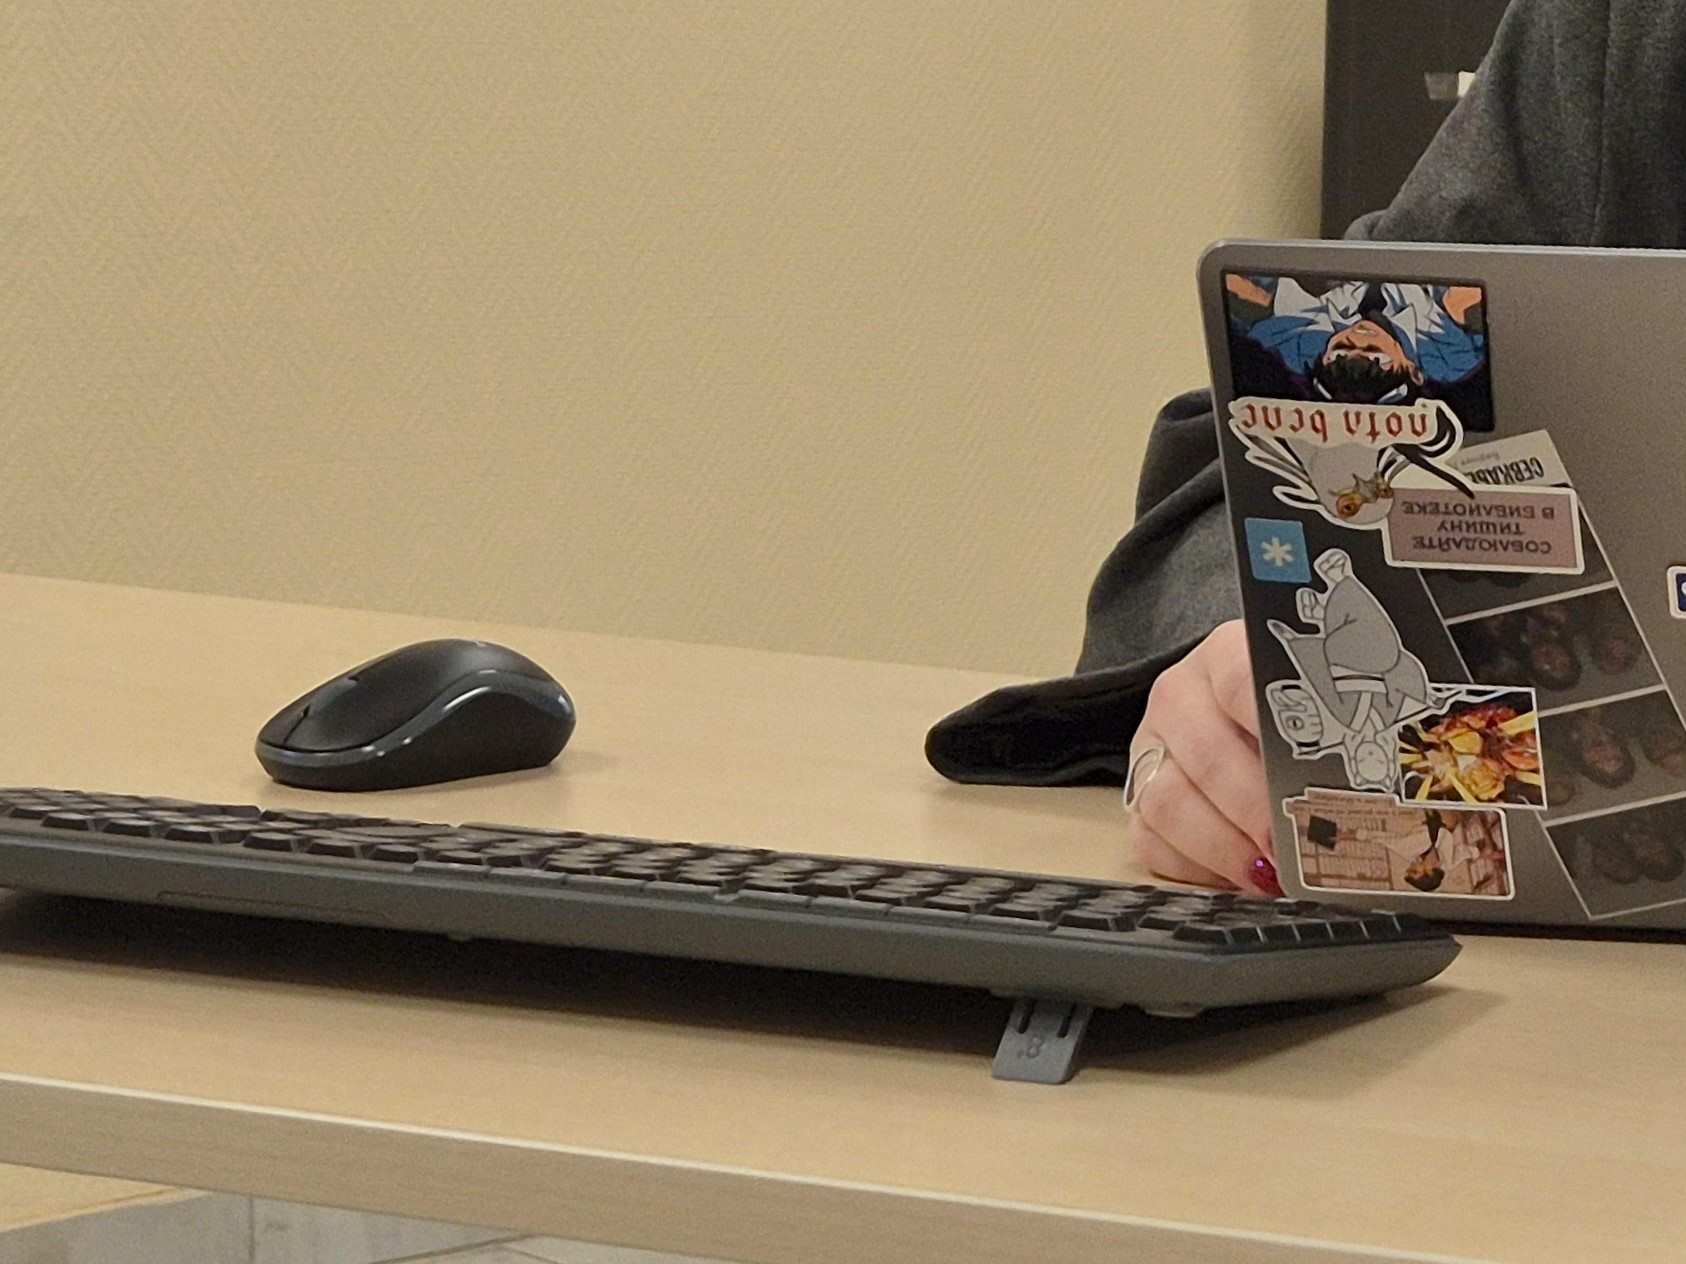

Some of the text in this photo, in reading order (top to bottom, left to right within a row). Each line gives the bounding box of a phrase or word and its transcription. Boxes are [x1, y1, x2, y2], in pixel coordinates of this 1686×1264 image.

[1400, 500, 1554, 518] В БИБЛИОТЕКЕ
[1435, 518, 1523, 534] ТИШИНУ
[1411, 534, 1550, 555] СОБЛЮДАЙТЕ
